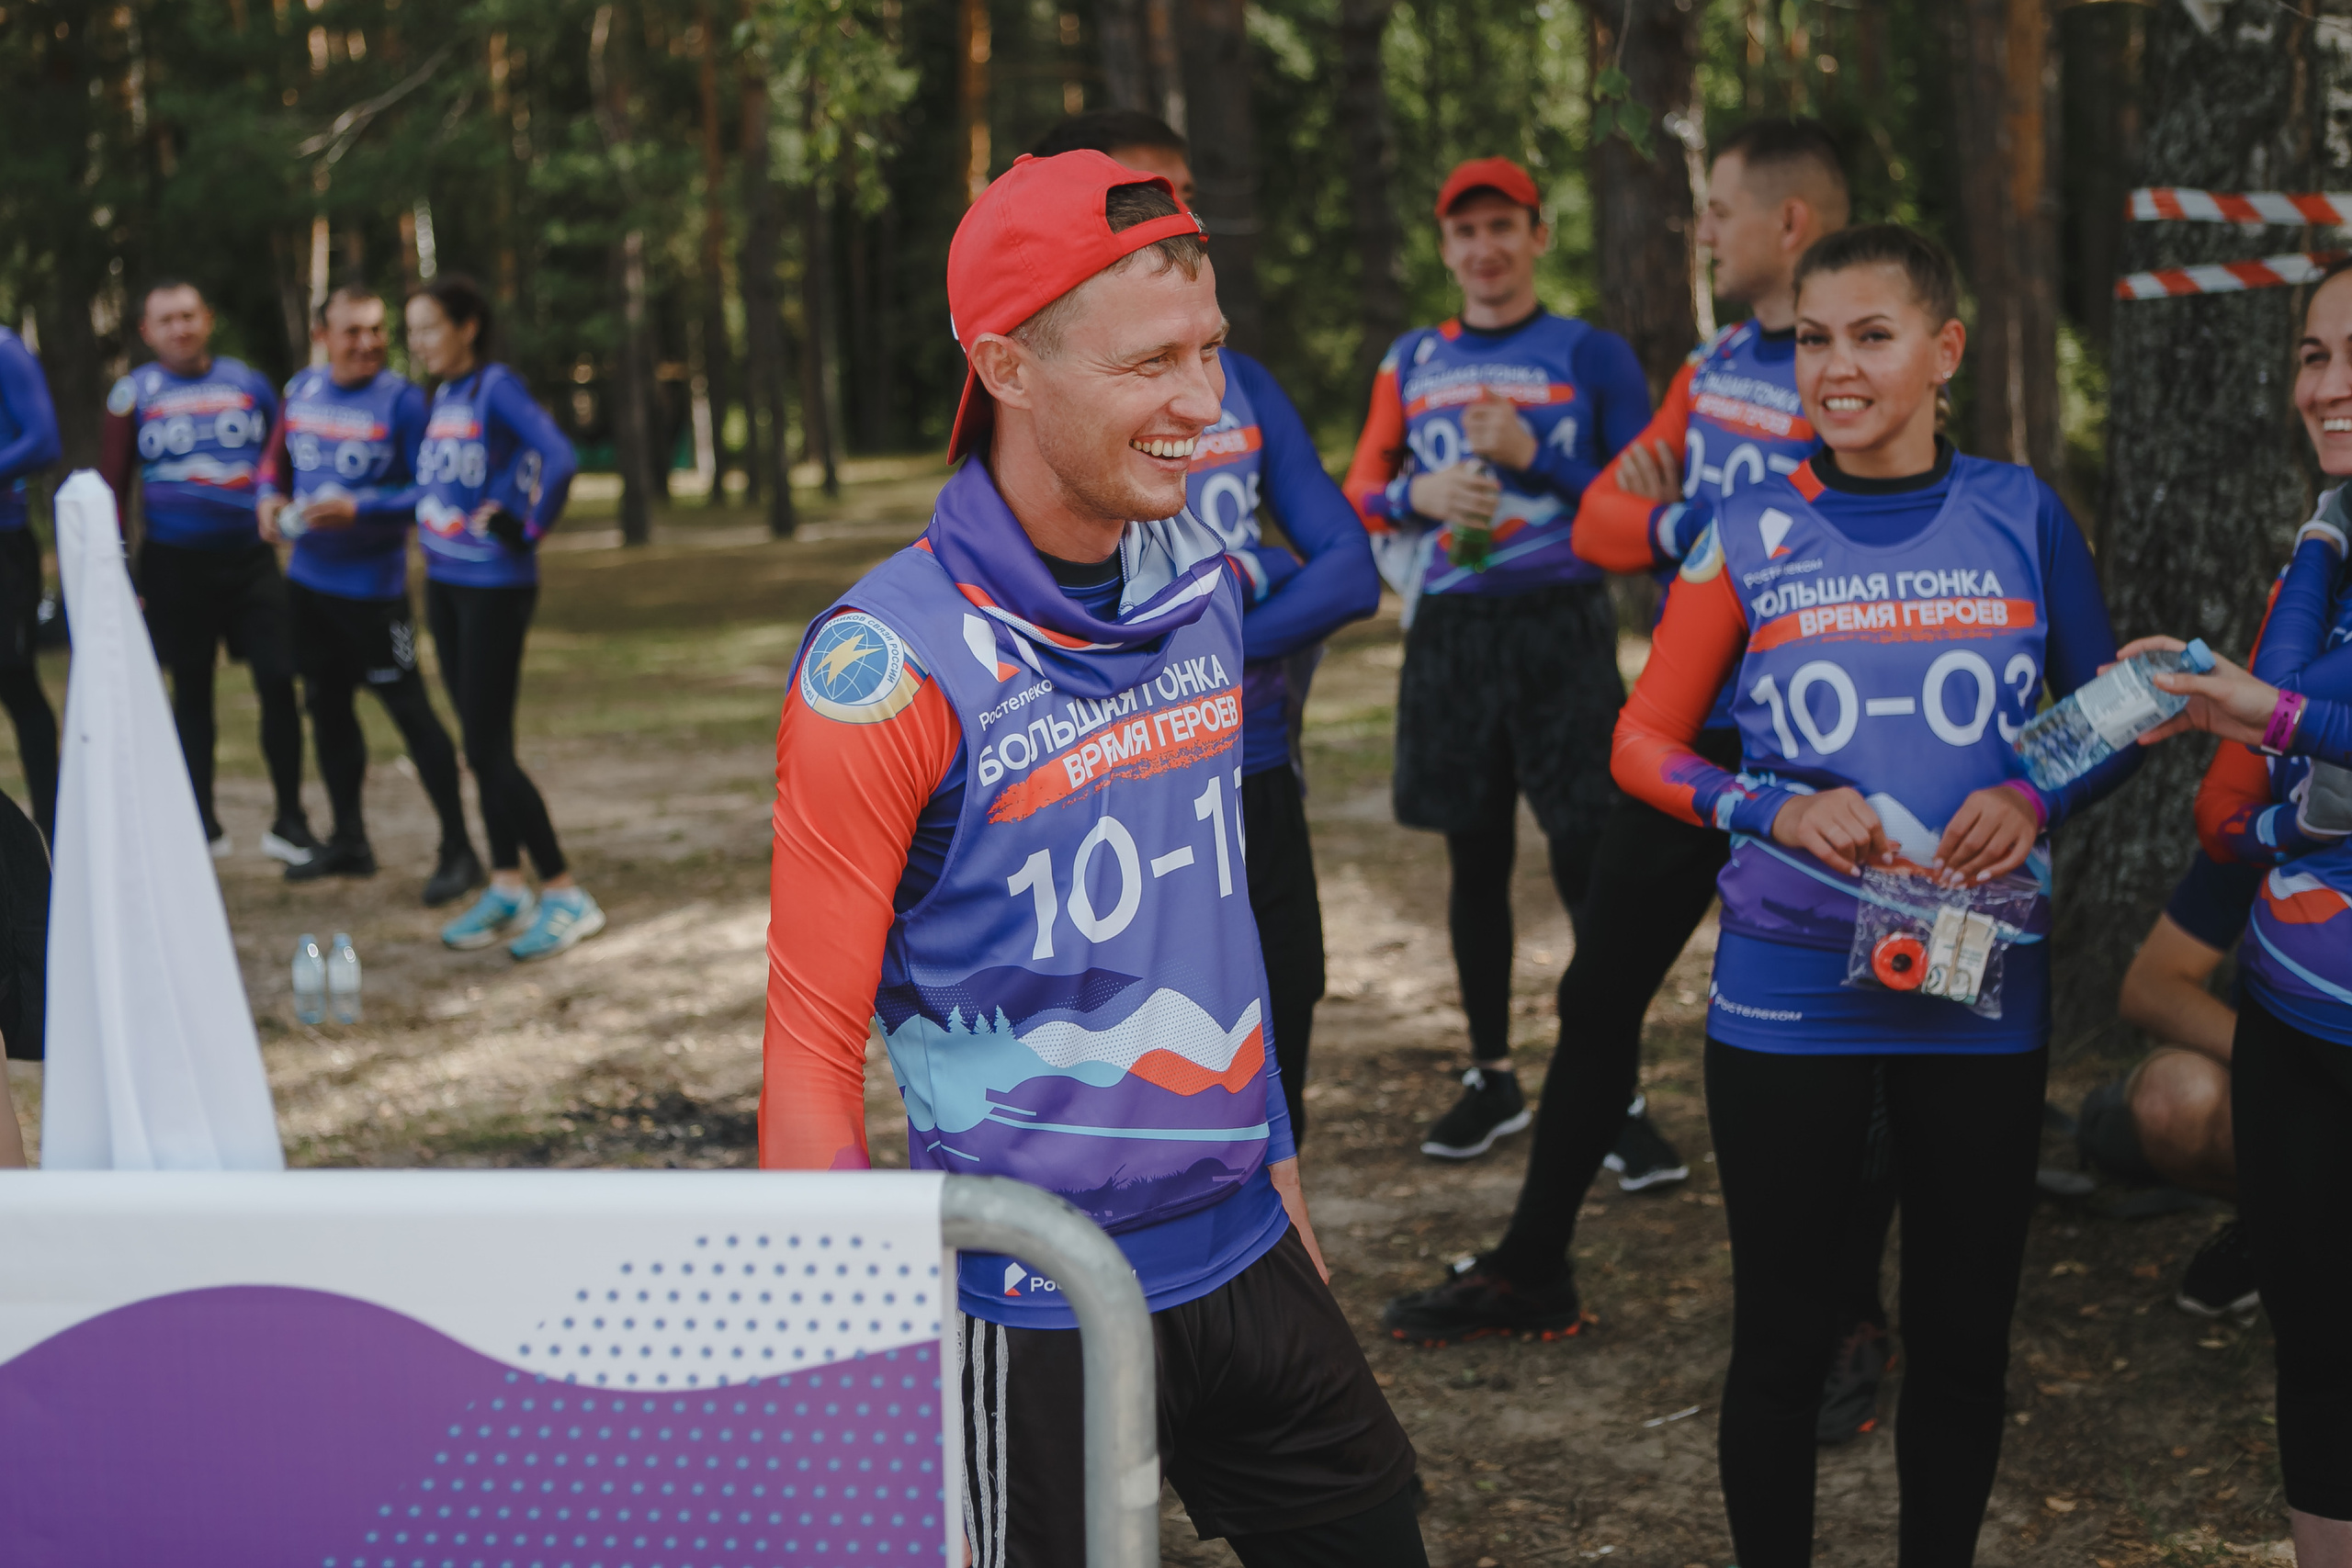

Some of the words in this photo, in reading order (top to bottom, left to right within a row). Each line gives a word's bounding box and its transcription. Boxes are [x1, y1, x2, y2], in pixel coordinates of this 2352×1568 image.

[1896, 569, 2004, 599] ГОНКА
[1798, 601, 1897, 637] ВРЕМЯ
[1902, 600, 2008, 627] ГЕРОЕВ
[867, 619, 895, 642] СВЯЗИ
[888, 643, 899, 684] РОССИИ
[978, 679, 1056, 732] Ростелеко
[1062, 719, 1151, 789] ВРЕМЯ
[1152, 694, 1240, 747] ГЕРОЕВ
[1006, 765, 1246, 961] 10-1
